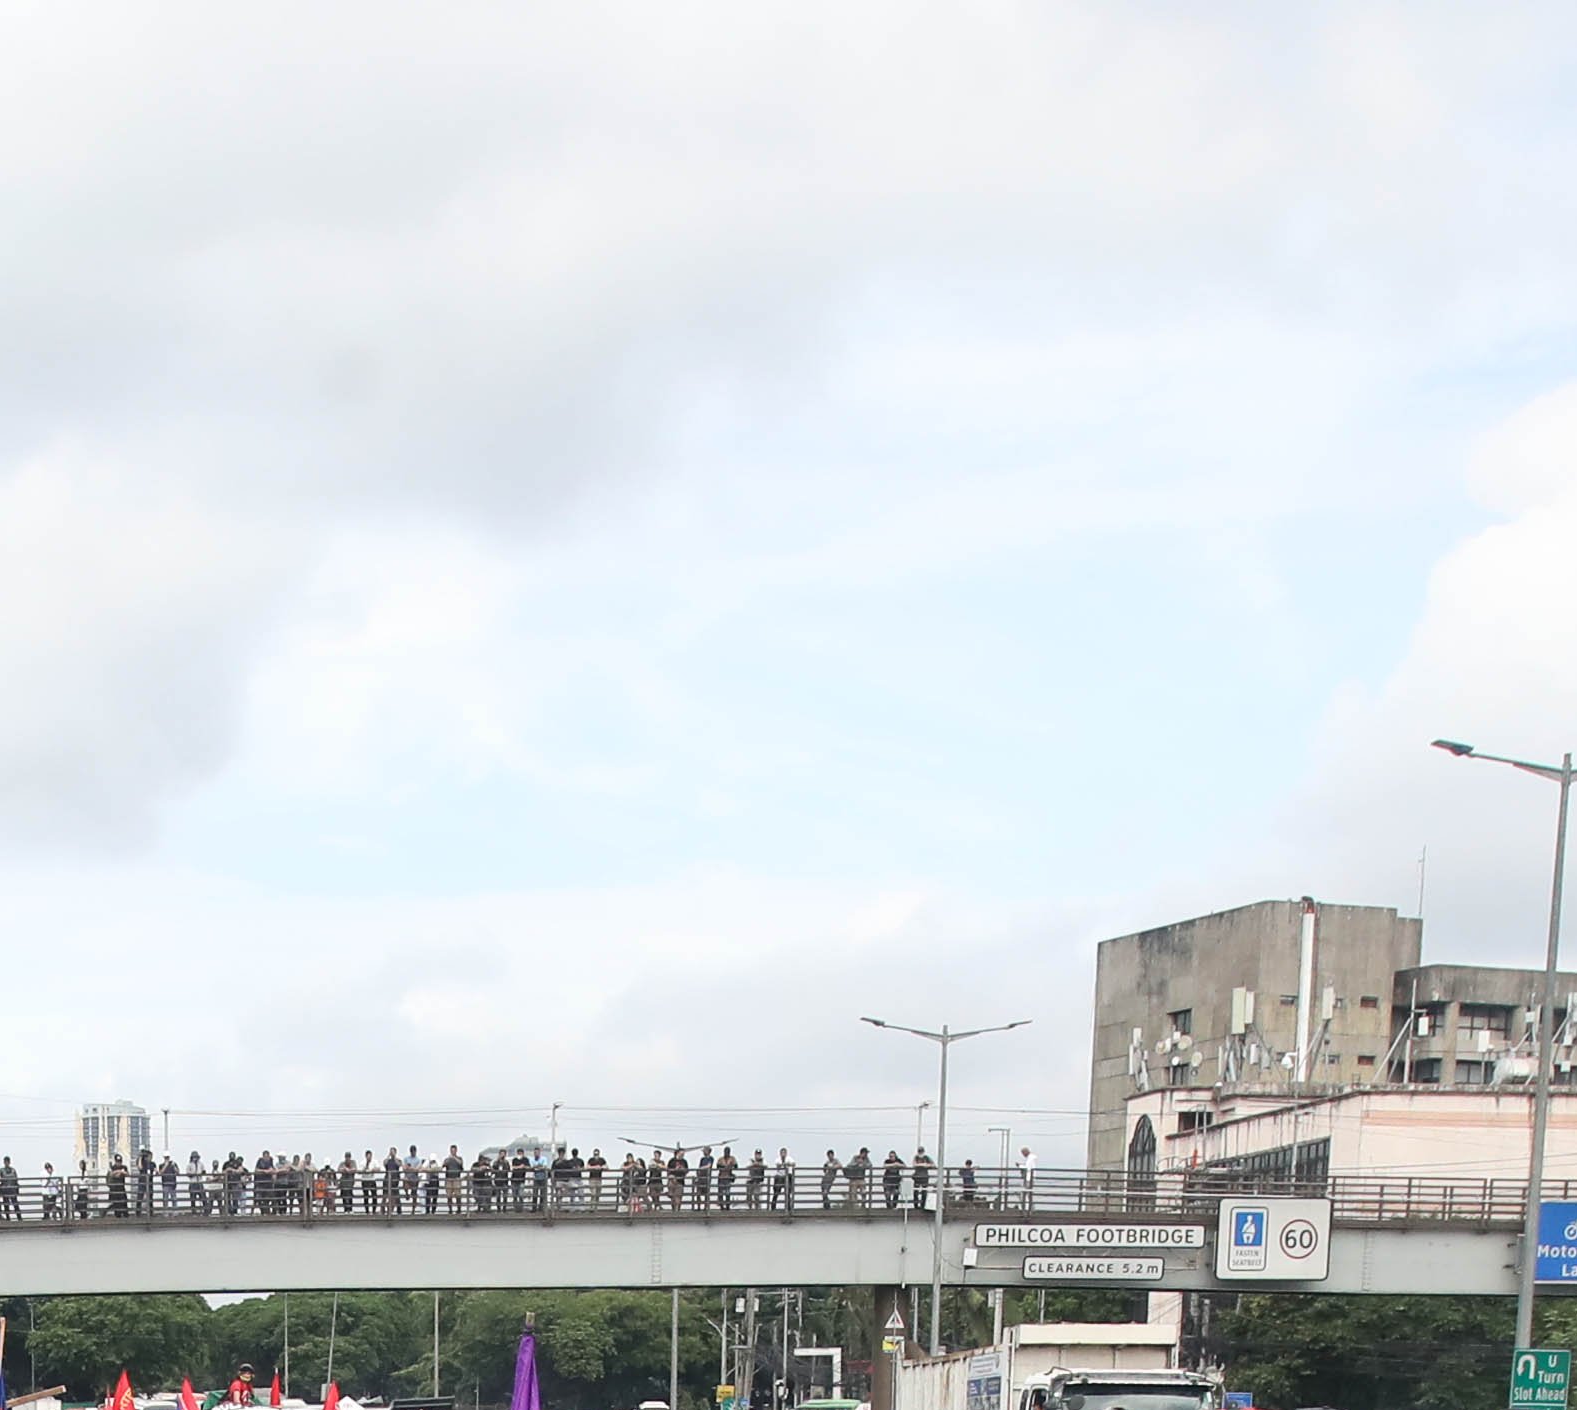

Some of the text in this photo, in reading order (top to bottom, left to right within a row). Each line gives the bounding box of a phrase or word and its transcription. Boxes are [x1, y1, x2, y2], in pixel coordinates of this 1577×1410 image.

[985, 1227, 1195, 1245] PHILCOA FOOTBRIDGE
[1285, 1229, 1313, 1249] 60
[1028, 1262, 1159, 1274] CLEARANCE 5.2 m
[1548, 1355, 1558, 1368] U
[1538, 1372, 1565, 1385] Turn
[1514, 1387, 1565, 1401] Slot Ahead
